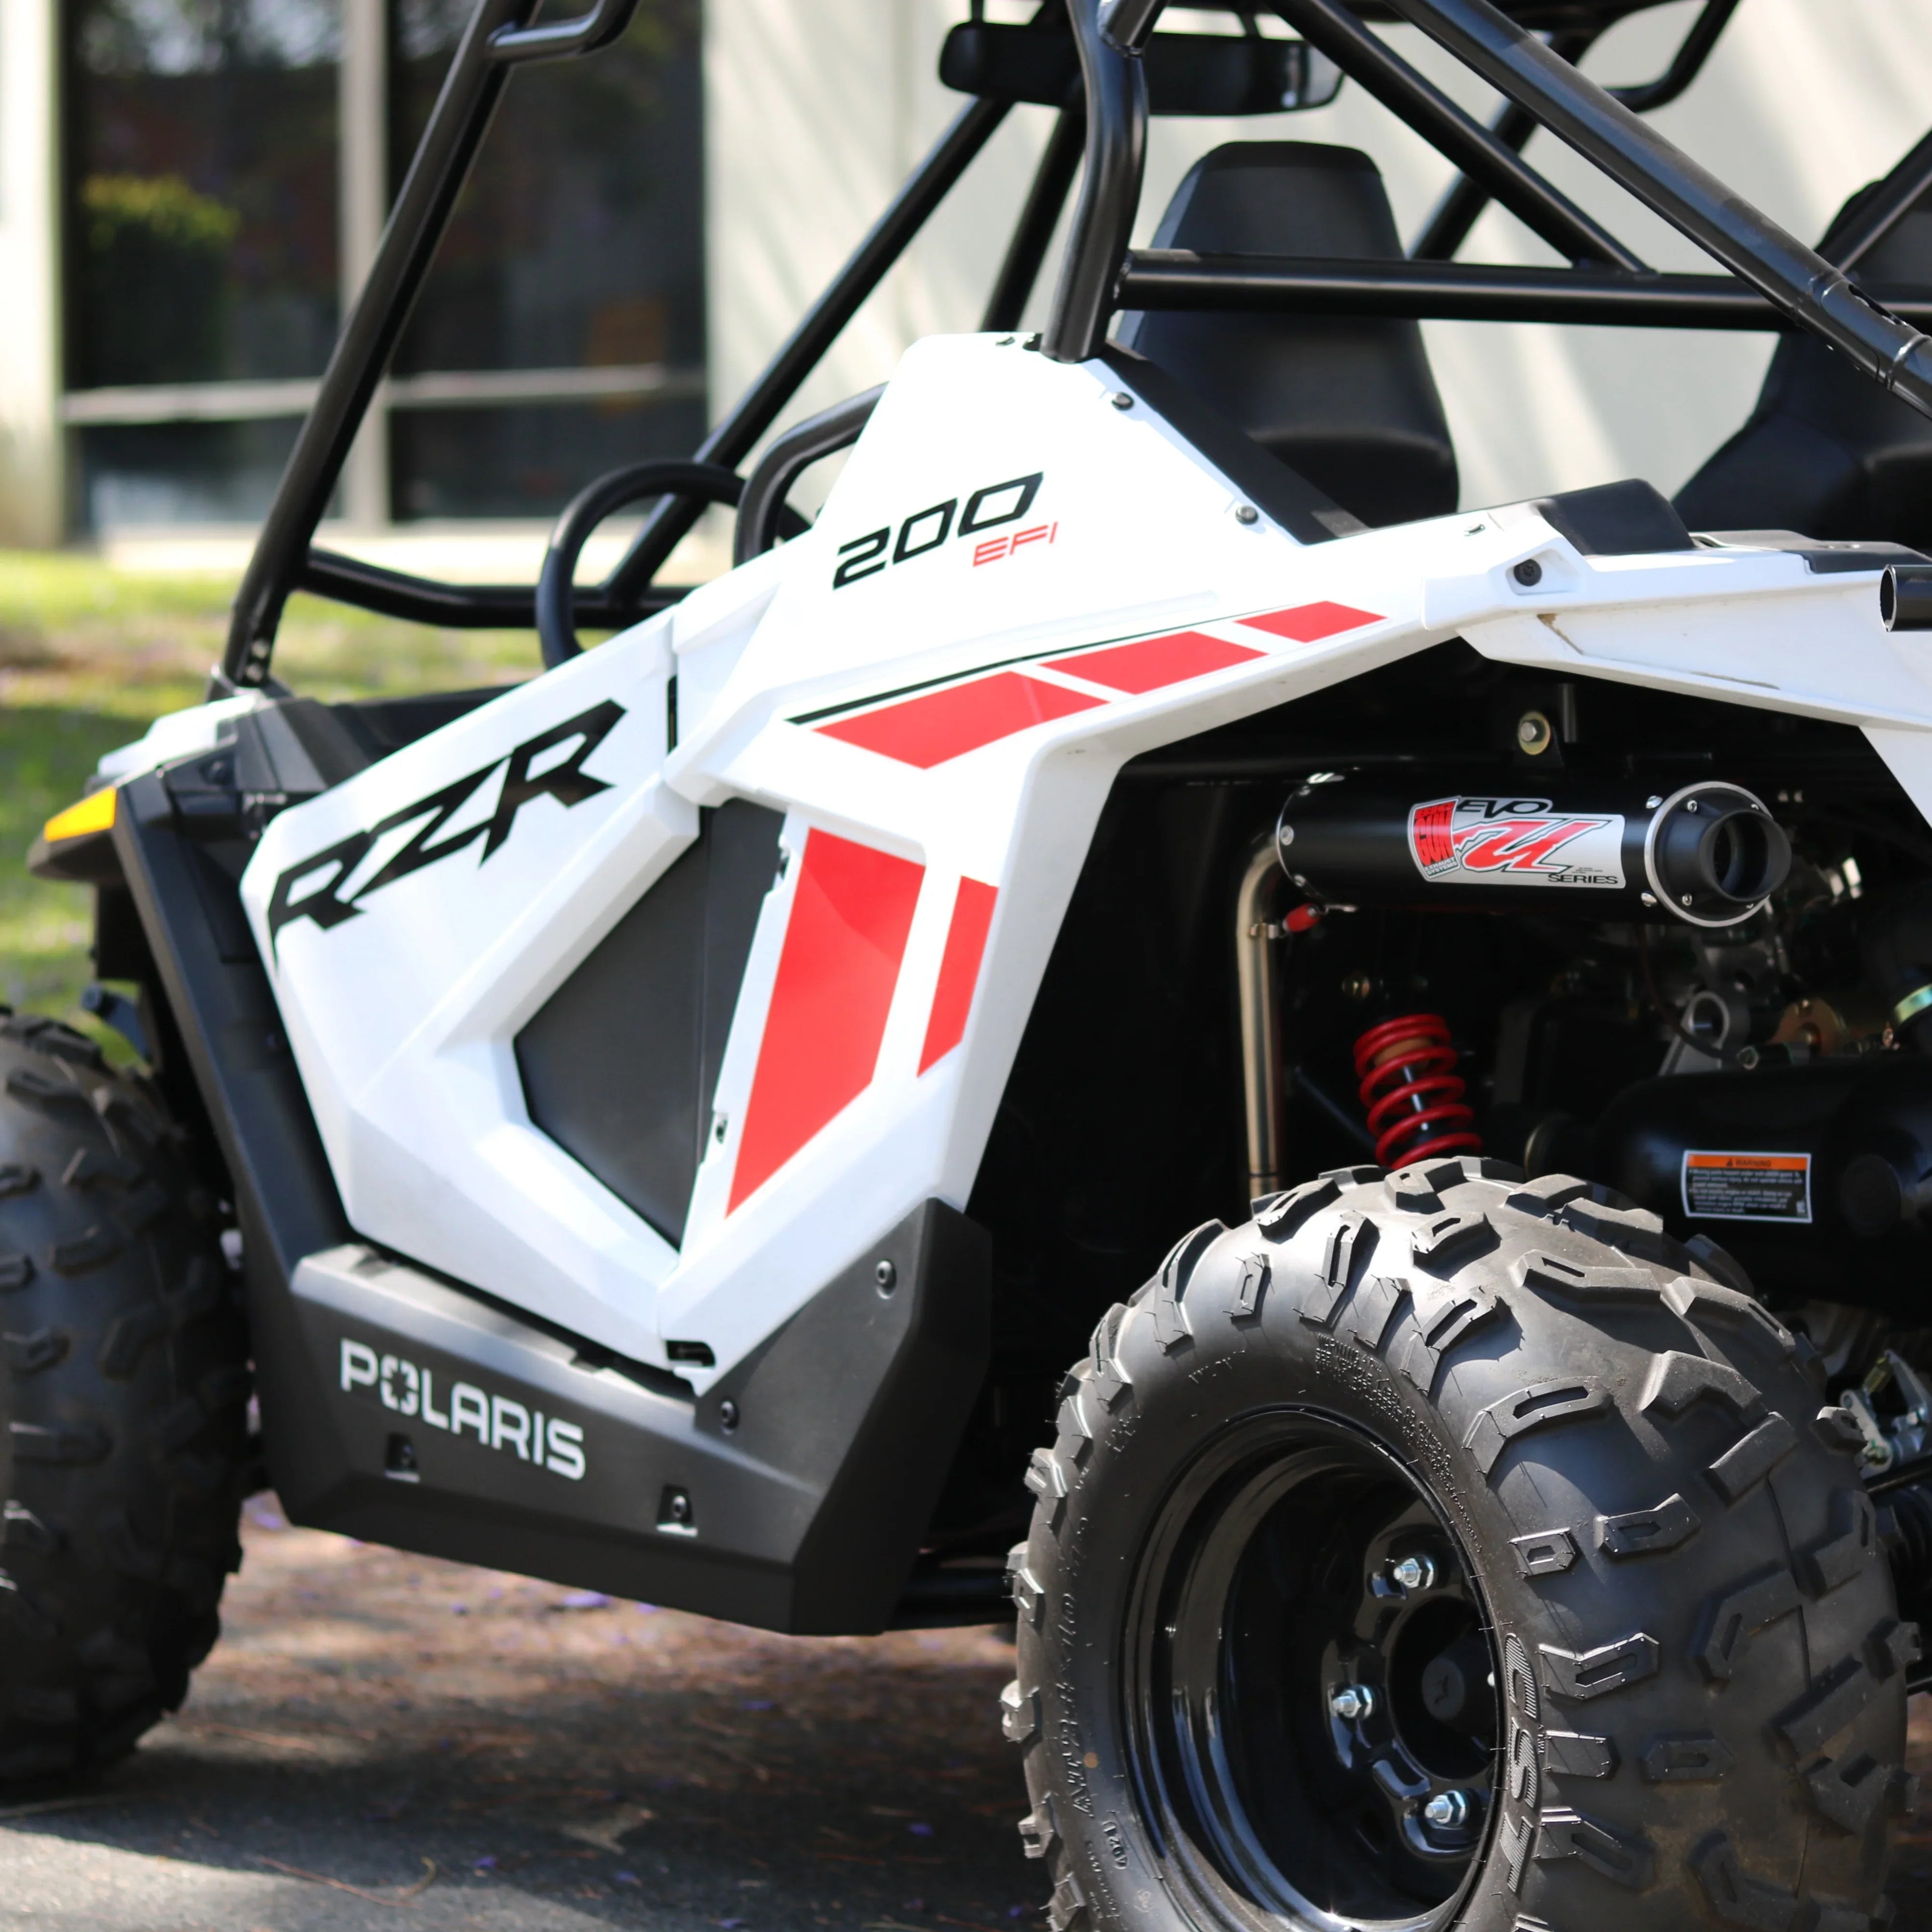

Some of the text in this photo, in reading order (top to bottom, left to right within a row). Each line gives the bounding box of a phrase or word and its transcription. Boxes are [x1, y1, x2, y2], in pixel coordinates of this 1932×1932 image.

[833, 471, 1044, 591] 200
[973, 521, 1059, 567] EFI
[1456, 799, 1544, 818] EVO
[267, 697, 628, 979] RZR
[1414, 810, 1455, 867] GUN
[1425, 856, 1456, 871] EXHAUST
[1427, 861, 1458, 875] SYSTEMS
[1548, 873, 1618, 884] SERIES
[1736, 1158, 1772, 1167] WARNING
[340, 1338, 586, 1481] POLARIS
[1499, 1633, 1538, 1893] CST
